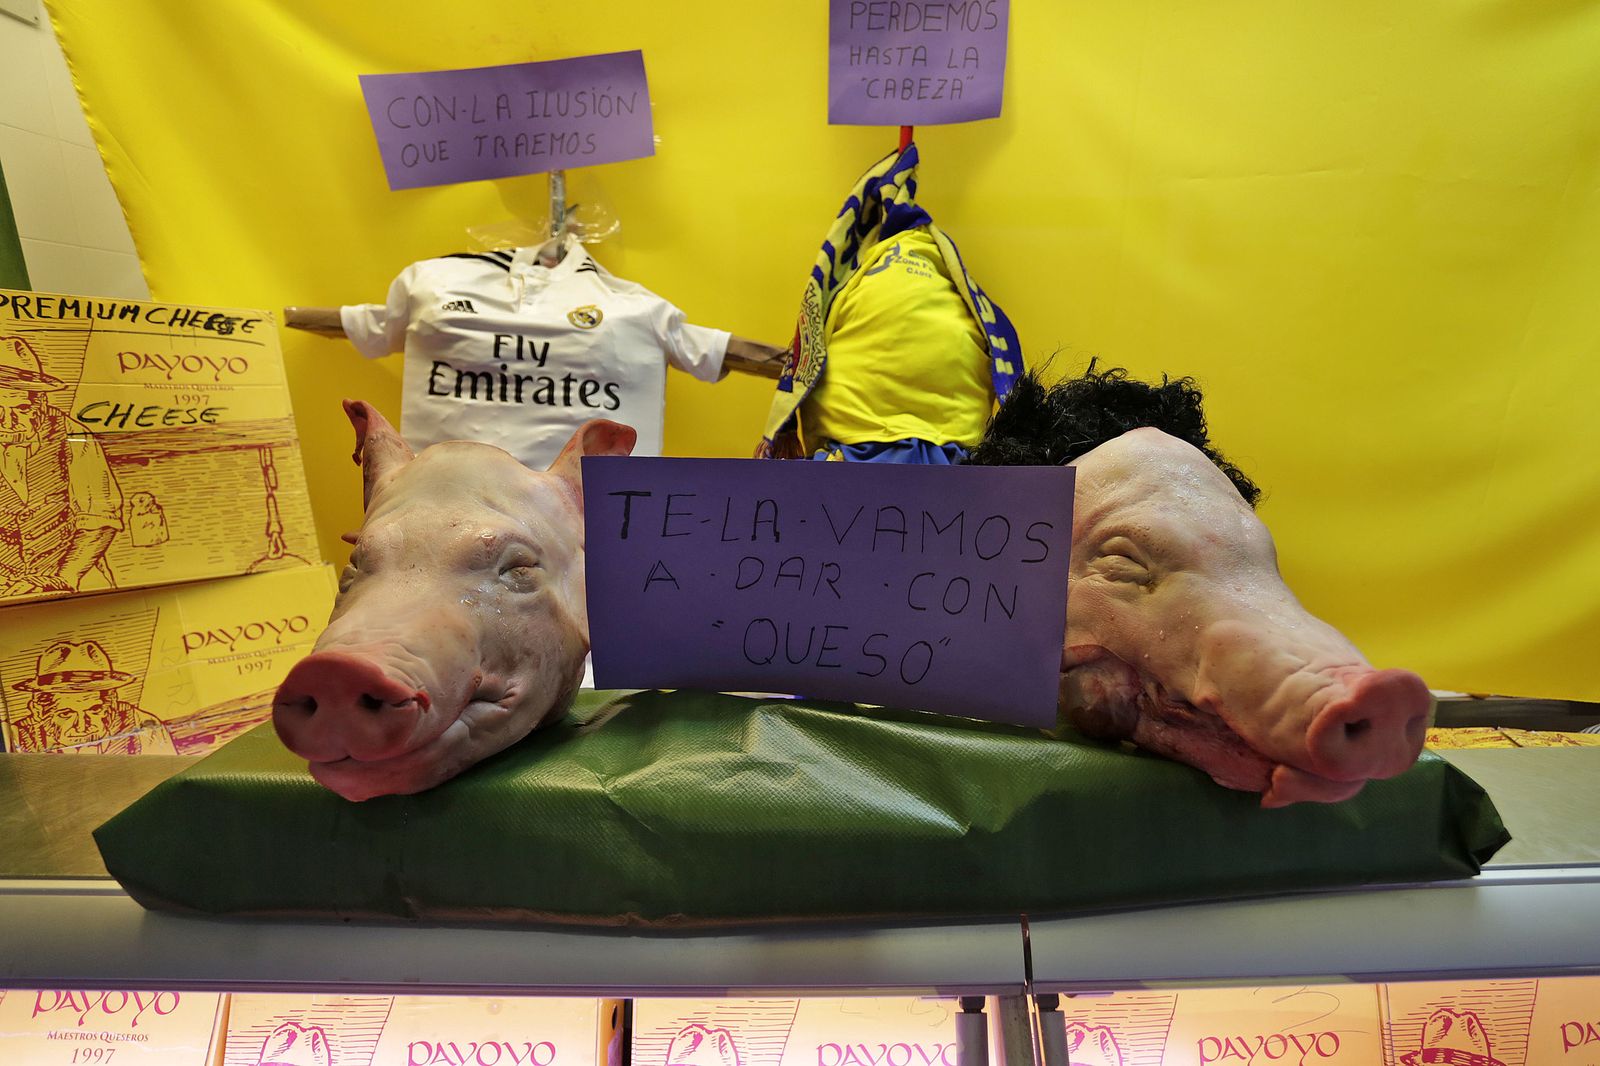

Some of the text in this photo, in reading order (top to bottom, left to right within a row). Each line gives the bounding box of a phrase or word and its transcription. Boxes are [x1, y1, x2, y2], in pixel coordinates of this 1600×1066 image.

[850, 0, 998, 32] PERDEMOS
[850, 46, 979, 69] HASTA LA
[401, 132, 596, 168] QUE TRAEMOS
[116, 351, 248, 382] PAYOYO
[493, 334, 550, 367] Fly
[173, 394, 210, 406] 1997
[428, 360, 621, 411] Emirates
[76, 401, 229, 428] CHEESE
[644, 556, 1018, 623] A DAR CON
[181, 615, 309, 655] PAYOYO
[236, 659, 273, 675] 1997
[32, 990, 180, 1028] PAYOYO
[46, 1030, 149, 1044] MAESTROS QUESEROS
[1197, 1031, 1341, 1066] PAYOYO
[70, 1047, 116, 1066] 1997
